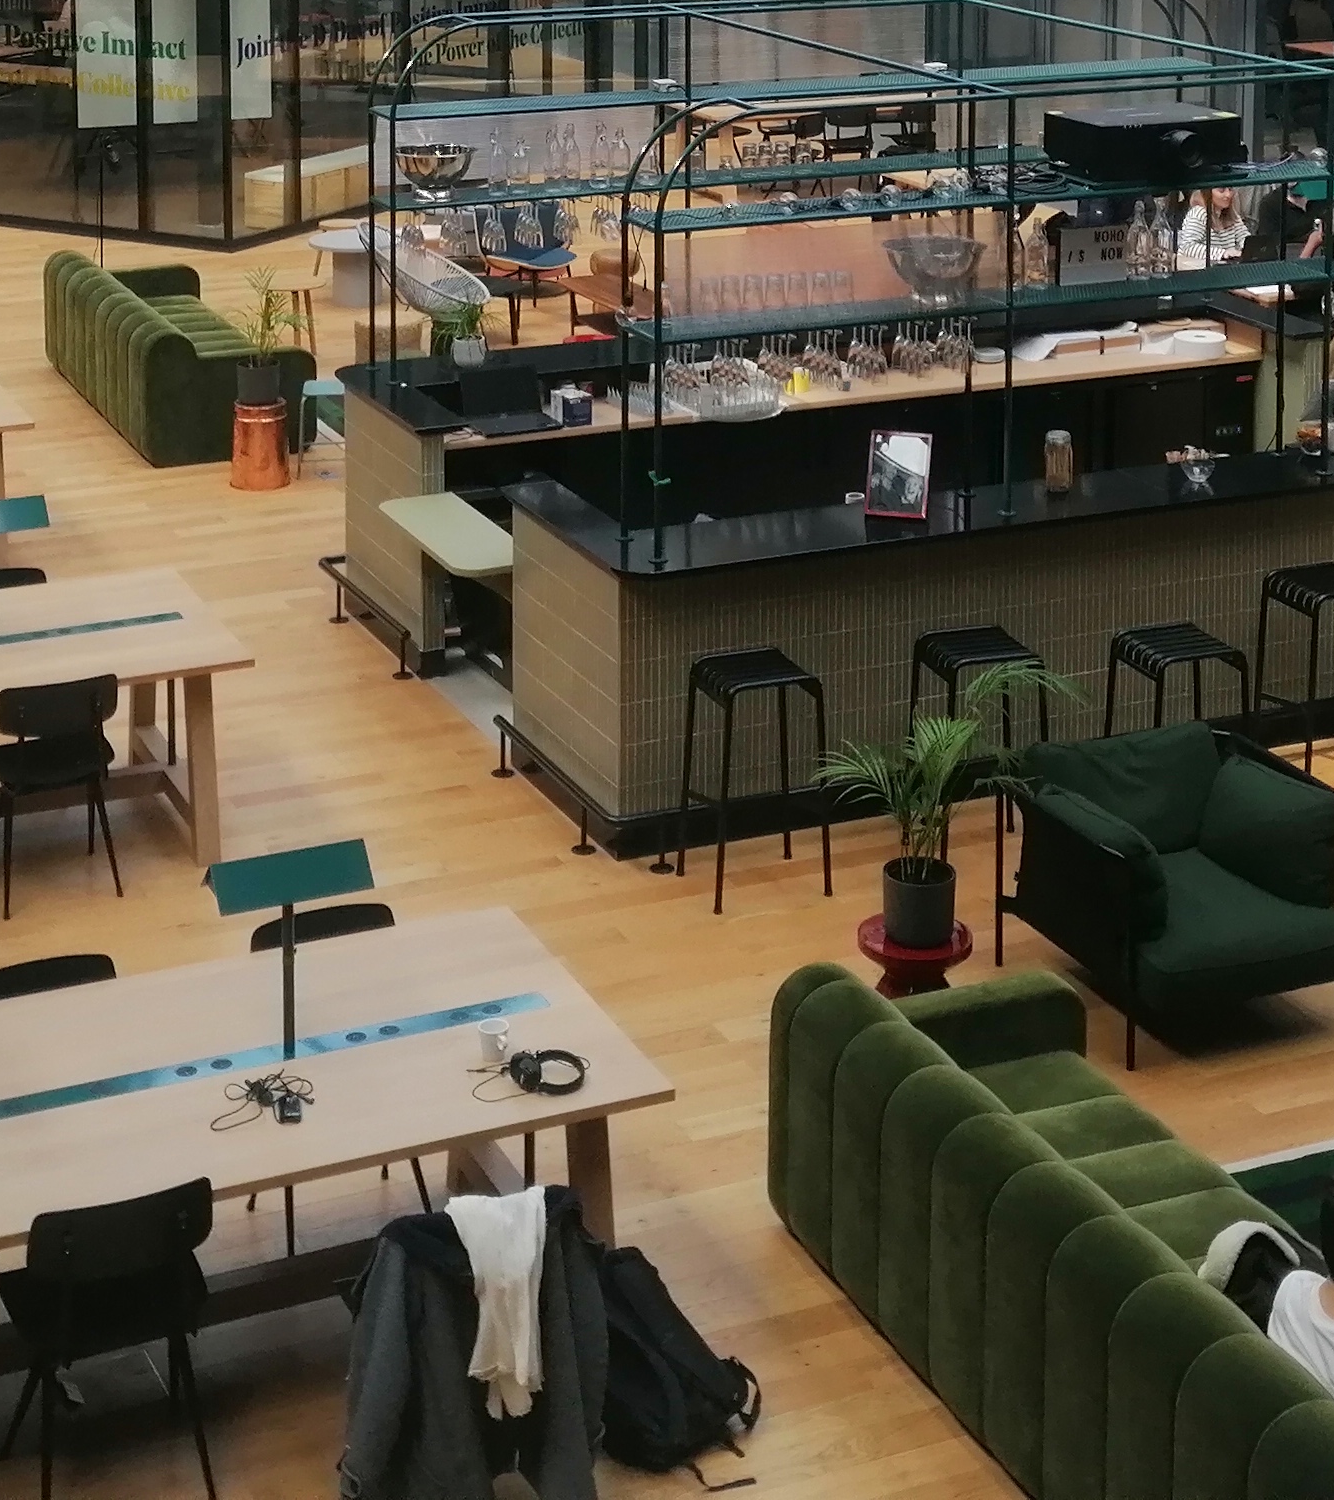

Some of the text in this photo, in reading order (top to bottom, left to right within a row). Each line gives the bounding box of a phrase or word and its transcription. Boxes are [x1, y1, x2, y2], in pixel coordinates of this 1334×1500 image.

[4, 23, 96, 53] Positive
[102, 31, 188, 60] Imact
[235, 34, 274, 69] Join
[435, 39, 486, 64] Power
[77, 72, 190, 102] Colleive
[1101, 247, 1123, 261] NOW
